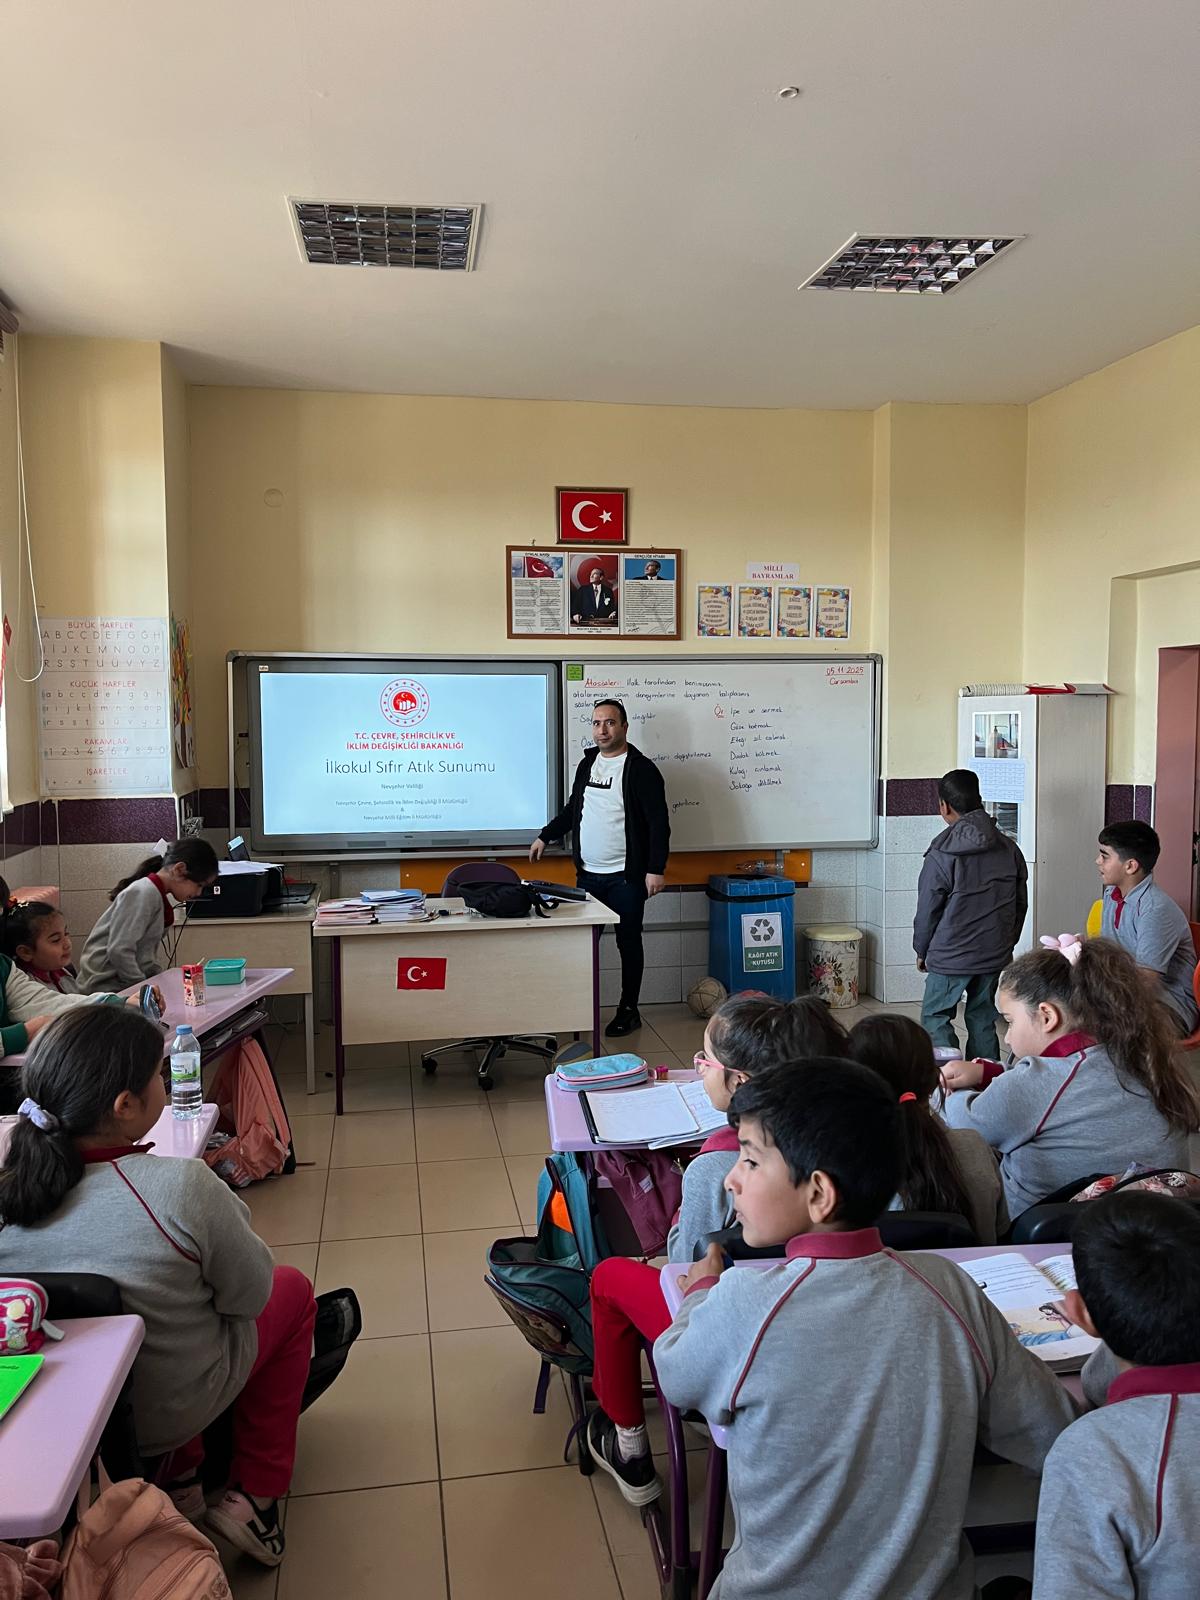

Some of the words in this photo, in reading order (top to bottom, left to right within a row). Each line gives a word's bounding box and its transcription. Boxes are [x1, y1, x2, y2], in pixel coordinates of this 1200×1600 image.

[752, 572, 794, 580] BAYRAMLAR
[354, 732, 369, 740] T.C.
[371, 732, 399, 741] ÇEVRE,
[401, 731, 444, 741] ŞEHİRCİLİK
[445, 732, 456, 740] VE
[346, 741, 369, 750] İKLİM
[371, 741, 419, 751] DEĞİŞİKLİĞİ
[420, 741, 464, 750] BAKANLIĞI
[325, 758, 372, 774] İlkokul
[376, 759, 403, 773] Sıfır
[407, 759, 434, 773] Atık
[438, 760, 496, 774] Sunumu
[752, 958, 775, 966] KUTUSU
